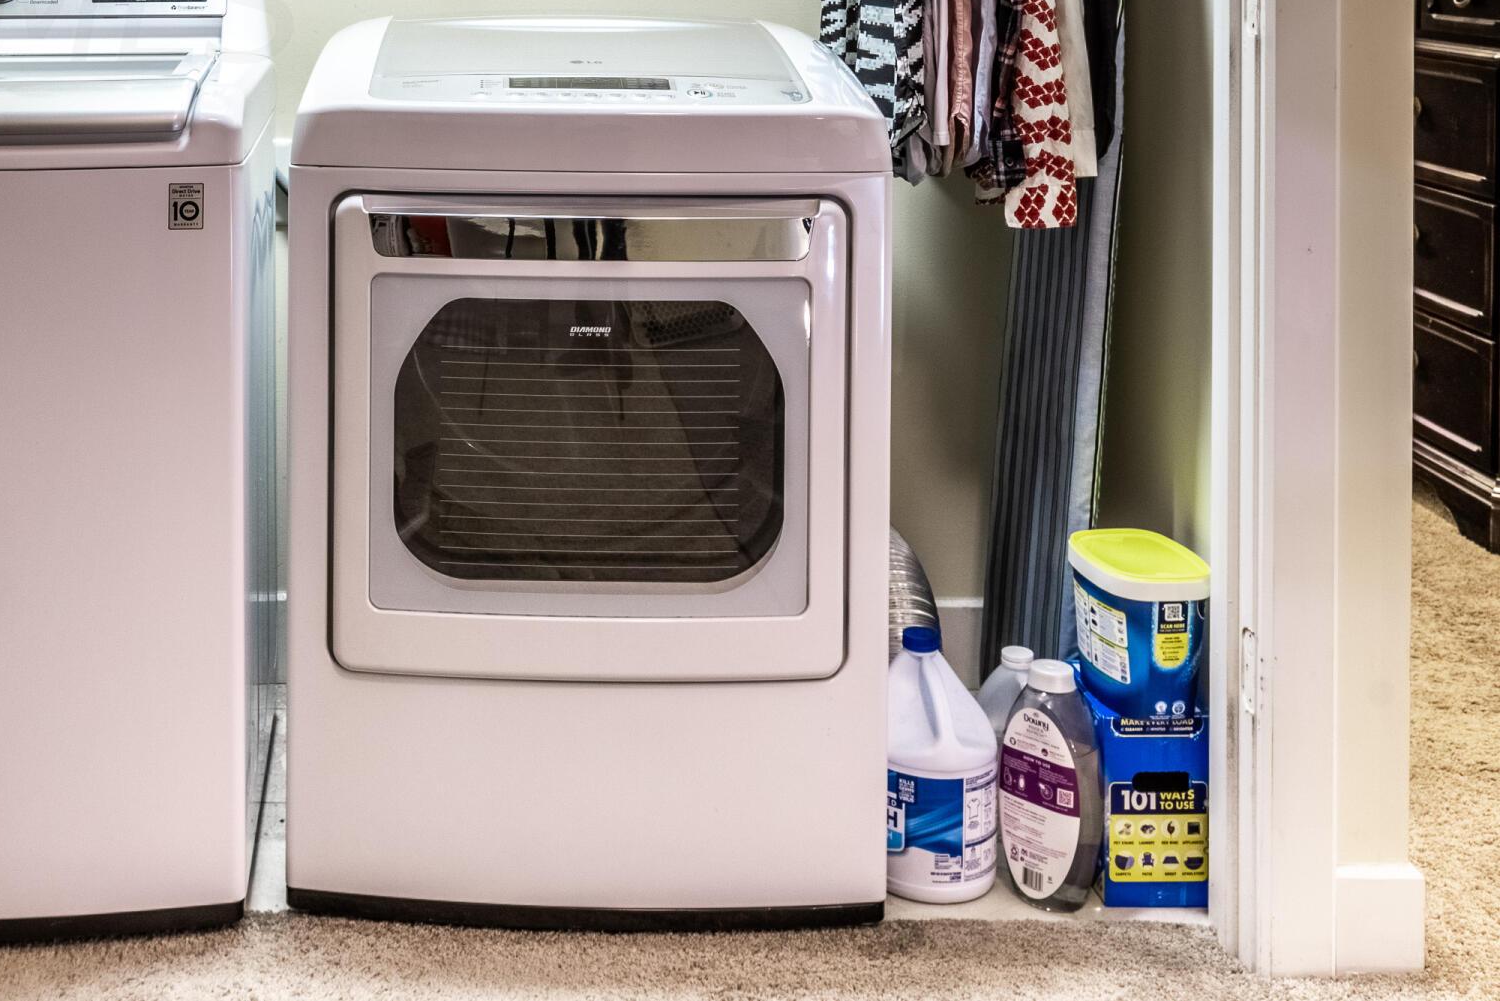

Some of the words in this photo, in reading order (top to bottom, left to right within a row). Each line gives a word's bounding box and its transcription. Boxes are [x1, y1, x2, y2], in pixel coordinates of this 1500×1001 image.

[172, 200, 199, 221] 10
[1023, 713, 1049, 731] Downy
[1121, 790, 1157, 810] 101
[1160, 801, 1174, 810] TO
[1176, 801, 1195, 810] USE
